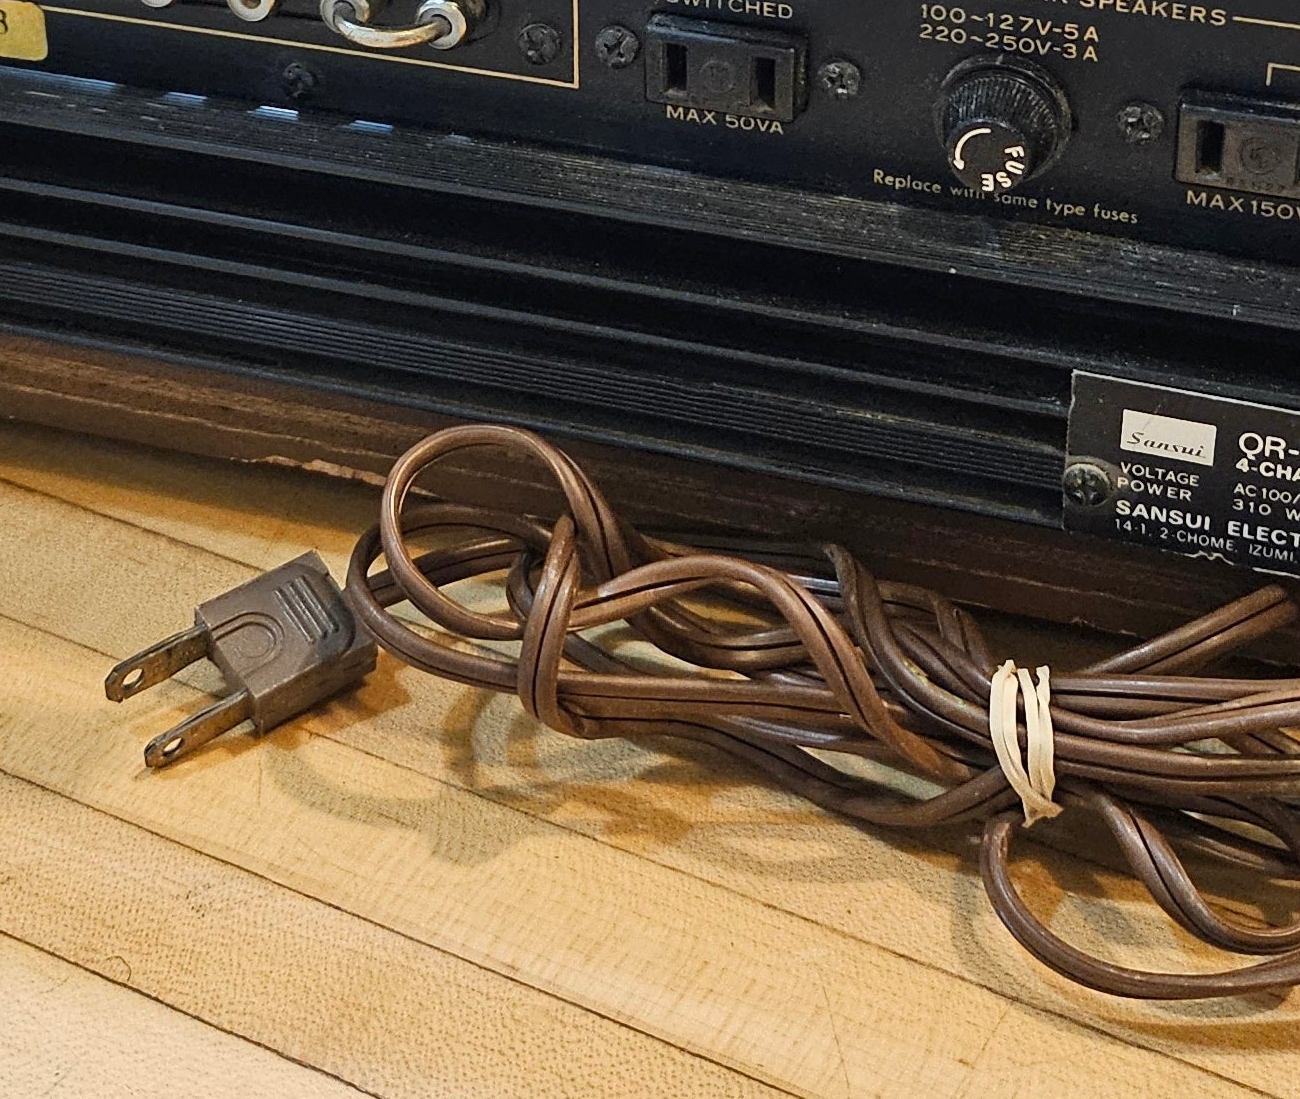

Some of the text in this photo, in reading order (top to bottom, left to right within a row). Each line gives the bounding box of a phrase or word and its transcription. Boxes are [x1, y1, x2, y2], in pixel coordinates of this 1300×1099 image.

[666, 105, 784, 135] MAX 50VA
[981, 145, 1025, 192] FUSE
[873, 169, 941, 194] Replace
[994, 192, 1037, 209] same
[1046, 200, 1085, 217] type
[1093, 204, 1138, 224] fuses
[1126, 431, 1206, 459] Sansui
[1120, 461, 1199, 486] VOLTAGE
[1117, 477, 1192, 501] POWER
[1115, 499, 1211, 531] SANSUI
[1232, 499, 1271, 515] 310
